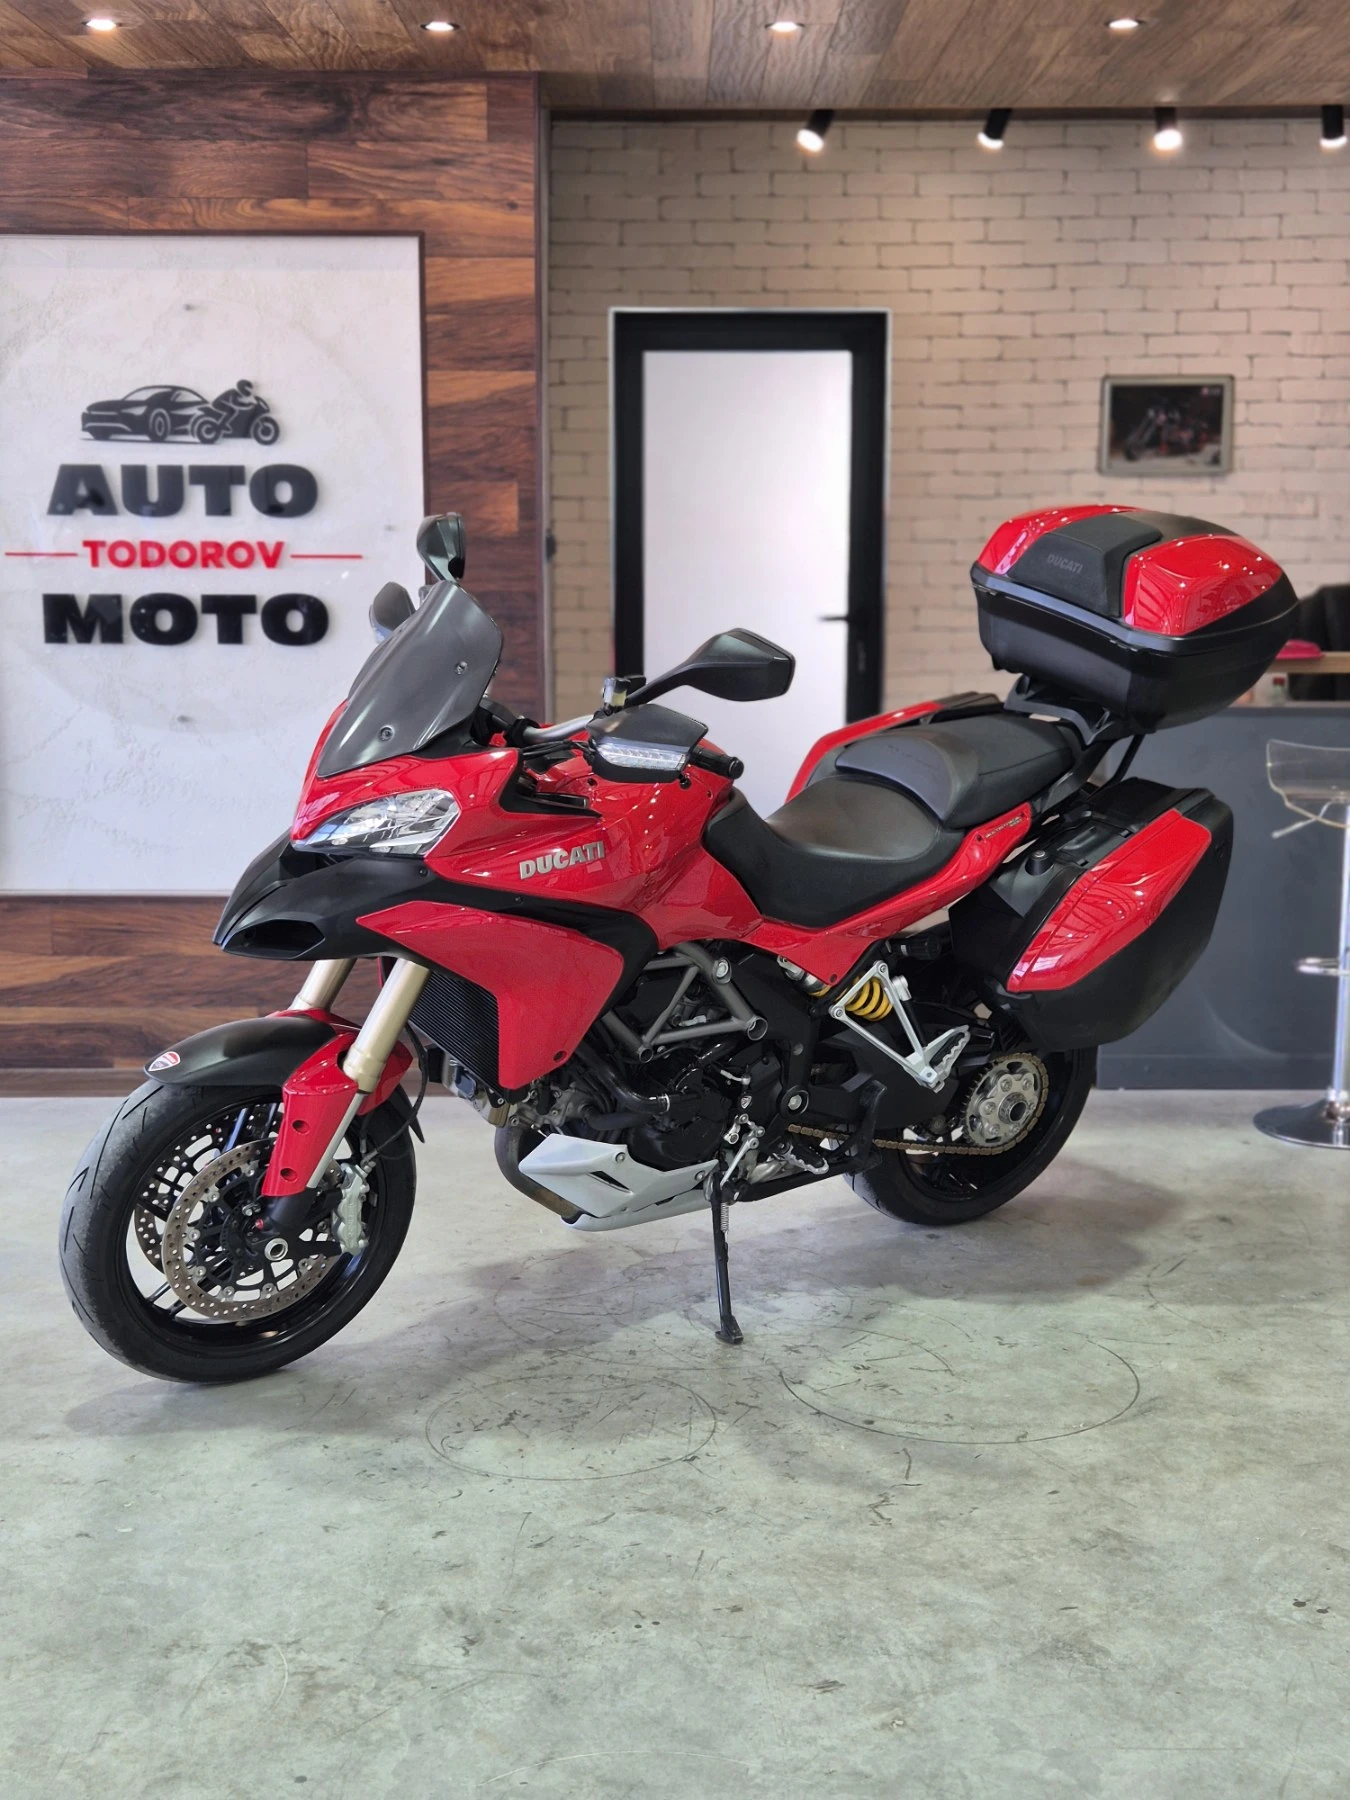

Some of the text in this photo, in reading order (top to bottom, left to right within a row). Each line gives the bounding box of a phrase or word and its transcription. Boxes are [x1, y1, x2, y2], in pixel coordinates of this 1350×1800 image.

[47, 463, 319, 518] AUTO
[82, 540, 285, 569] TODOROV
[1047, 553, 1083, 574] DUCATI
[42, 592, 330, 646] MOTO
[519, 840, 605, 880] DUCATI
